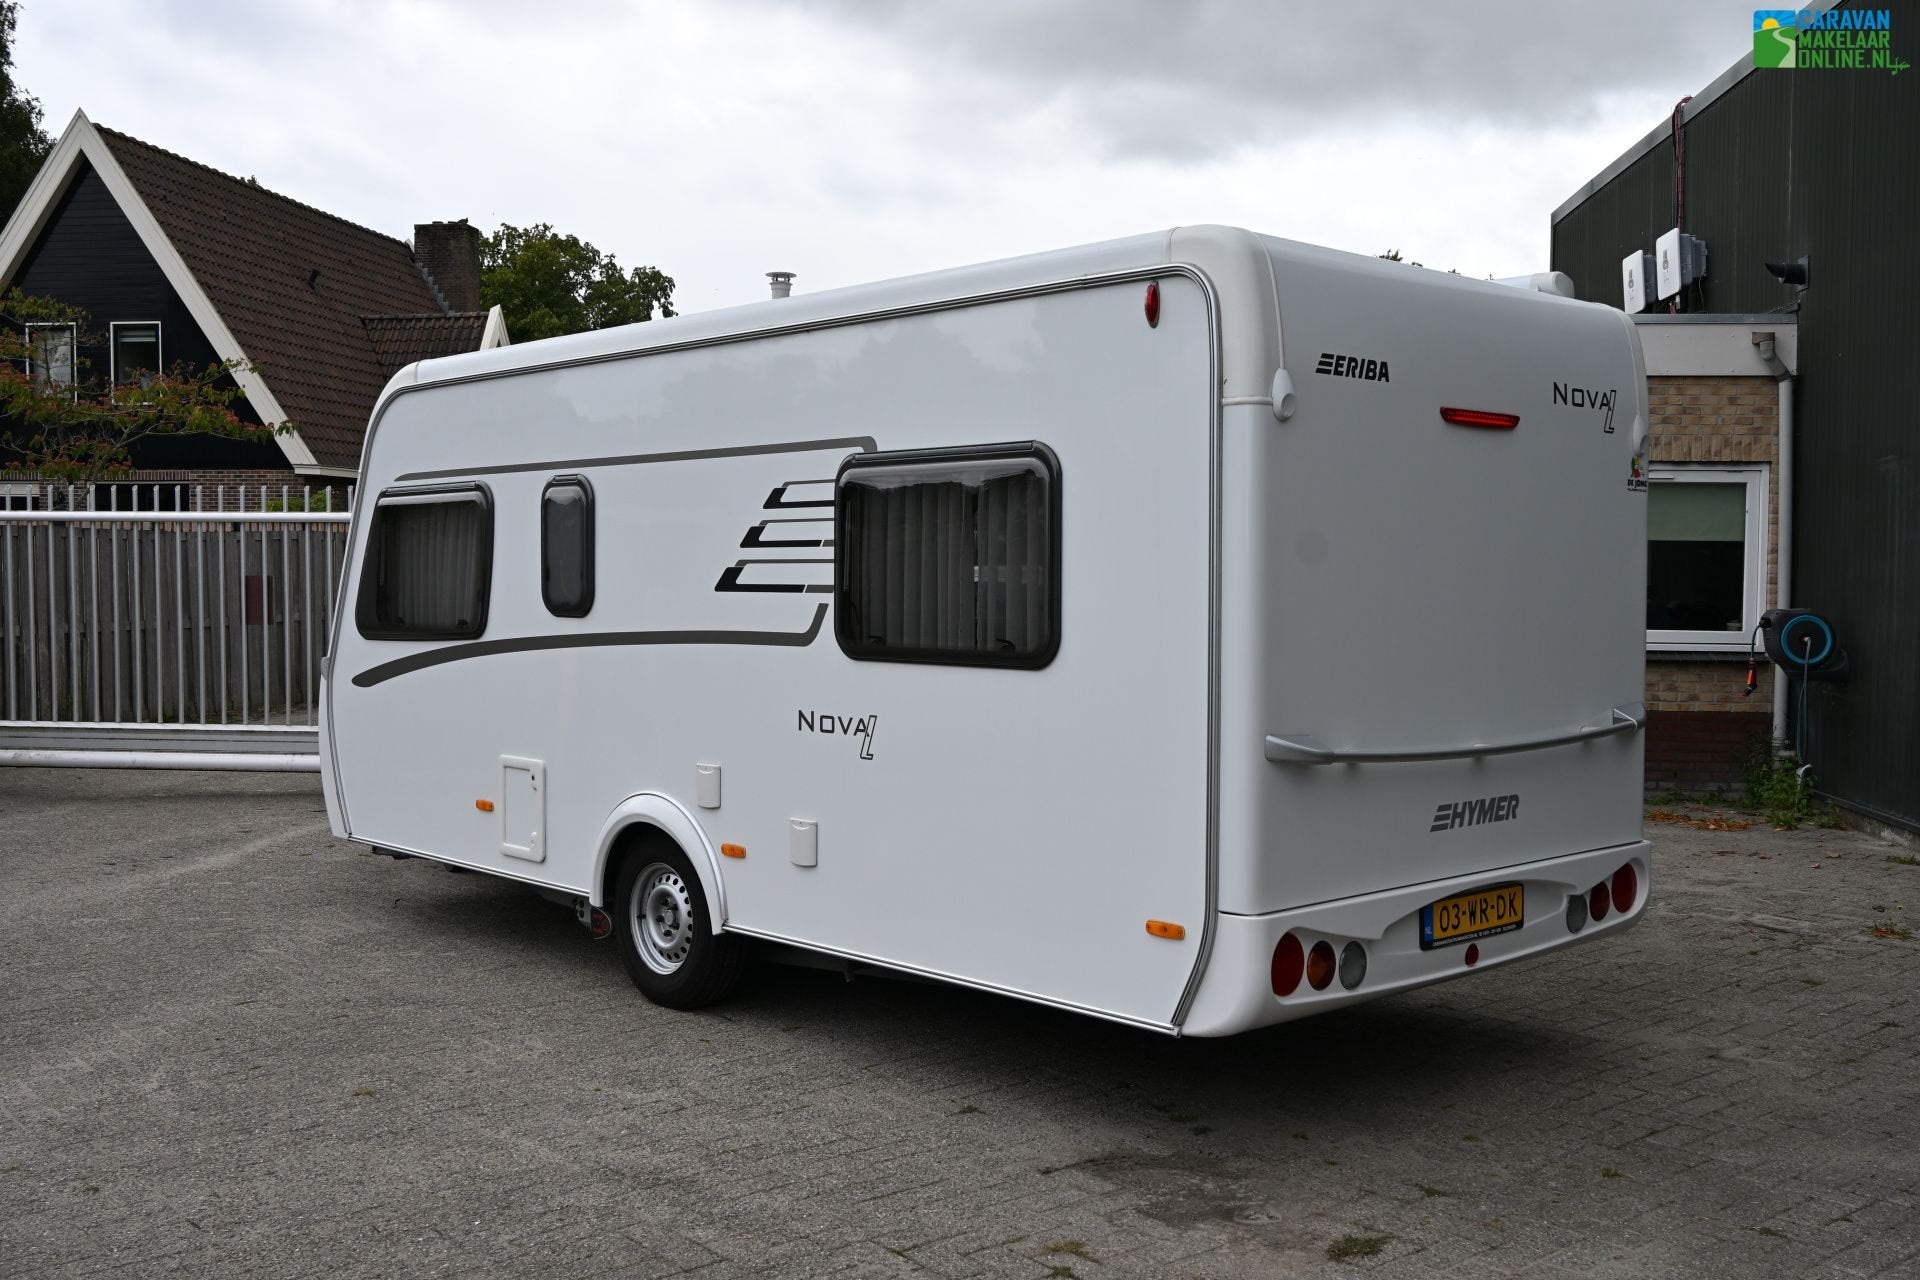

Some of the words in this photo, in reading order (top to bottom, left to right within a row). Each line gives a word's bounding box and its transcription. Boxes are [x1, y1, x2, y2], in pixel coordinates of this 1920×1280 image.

[1333, 355, 1390, 382] ERIBA
[1449, 794, 1520, 830] HYMER
[1439, 891, 1518, 933] 03-WR-DK
